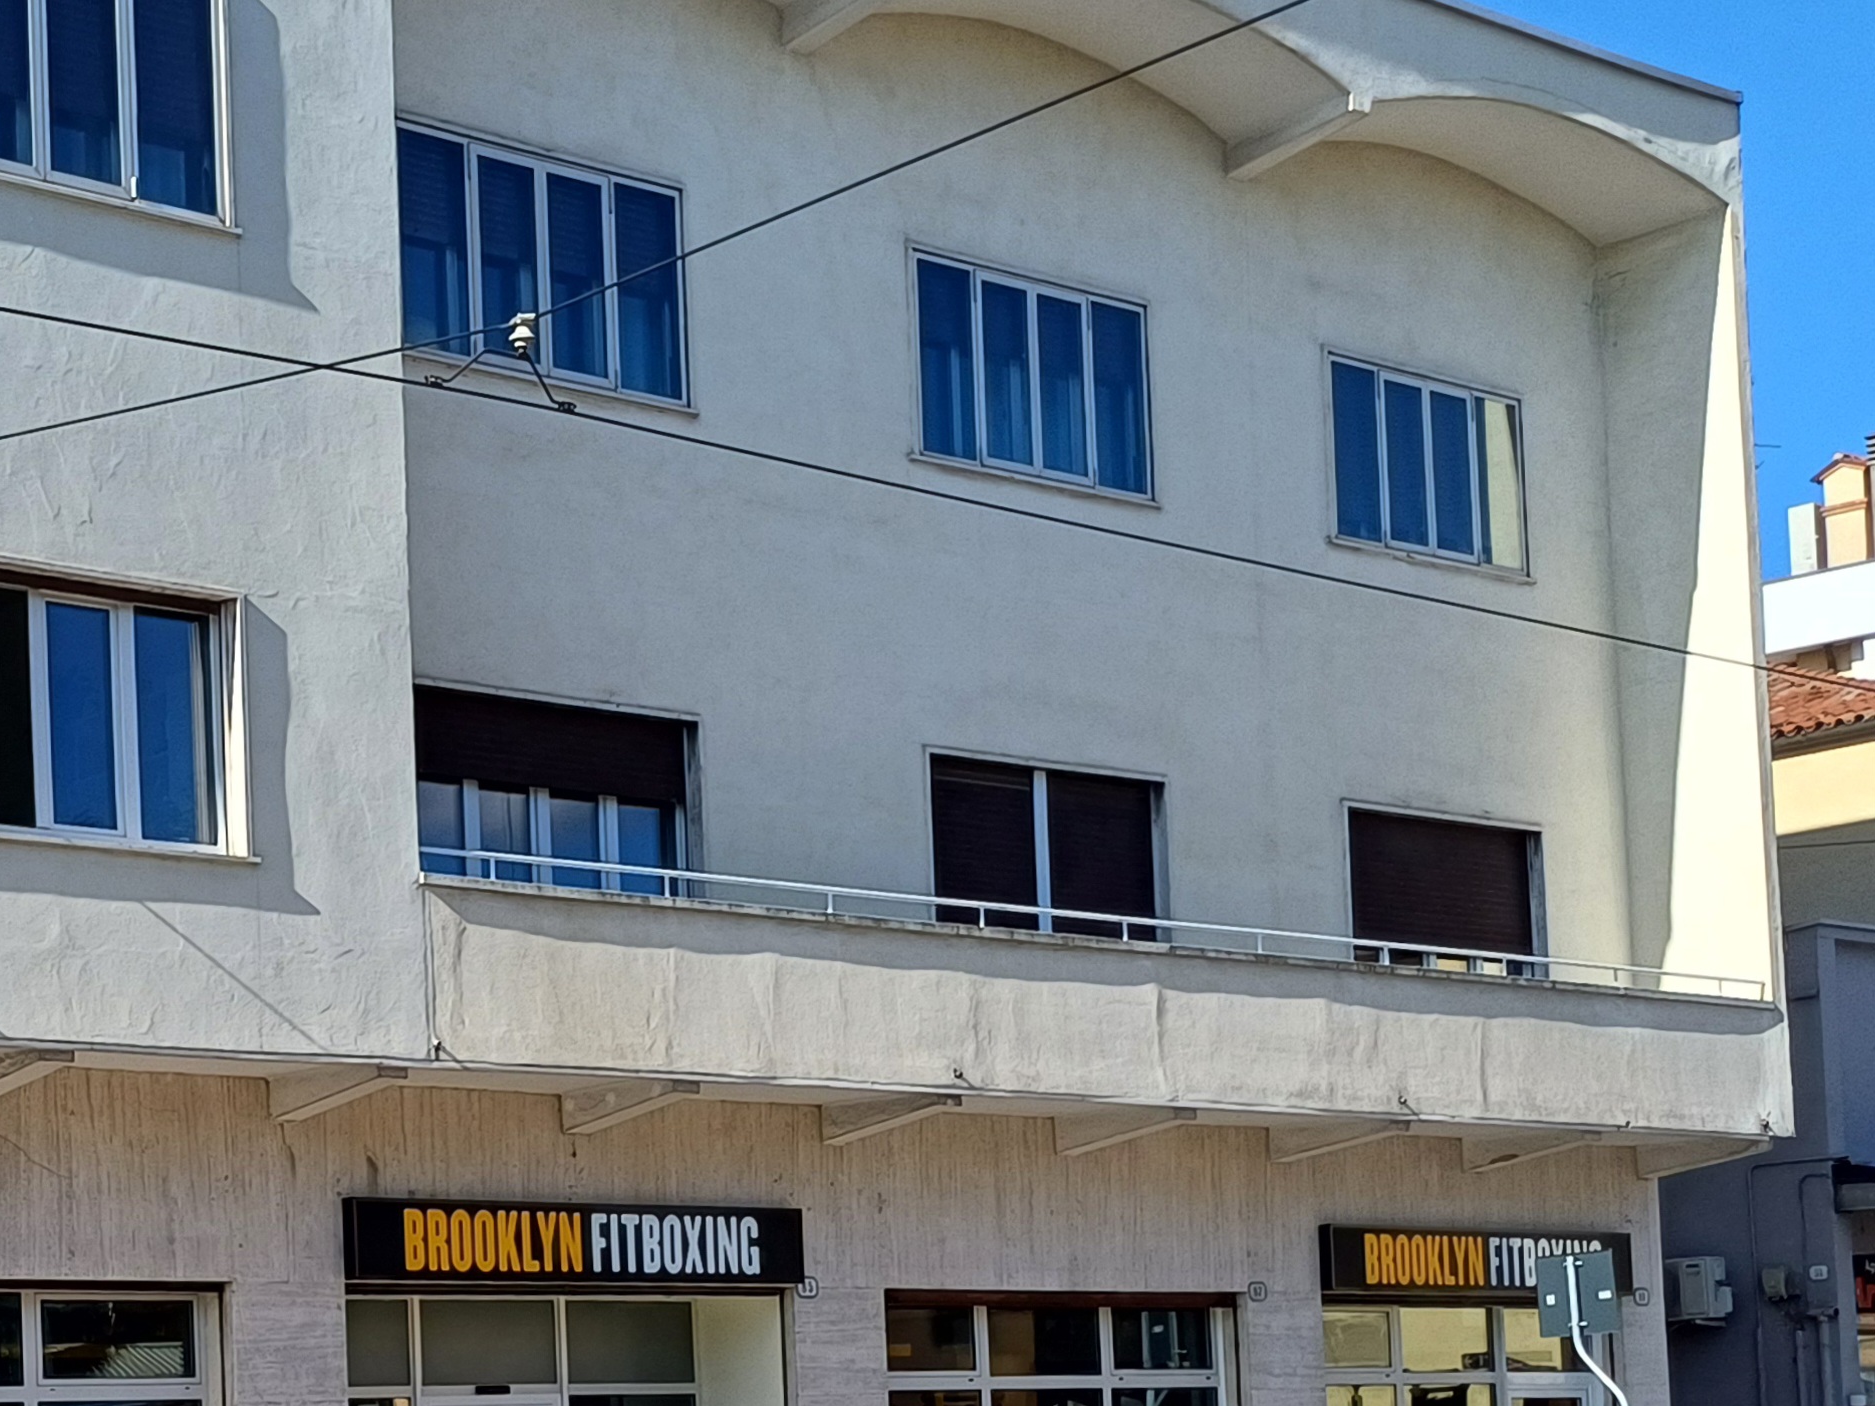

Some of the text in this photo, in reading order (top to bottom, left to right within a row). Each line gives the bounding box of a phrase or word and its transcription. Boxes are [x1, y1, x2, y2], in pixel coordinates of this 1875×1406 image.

[403, 1208, 761, 1275] BROOKLYN FITBOXING
[1363, 1233, 1485, 1286] BROOKLYN
